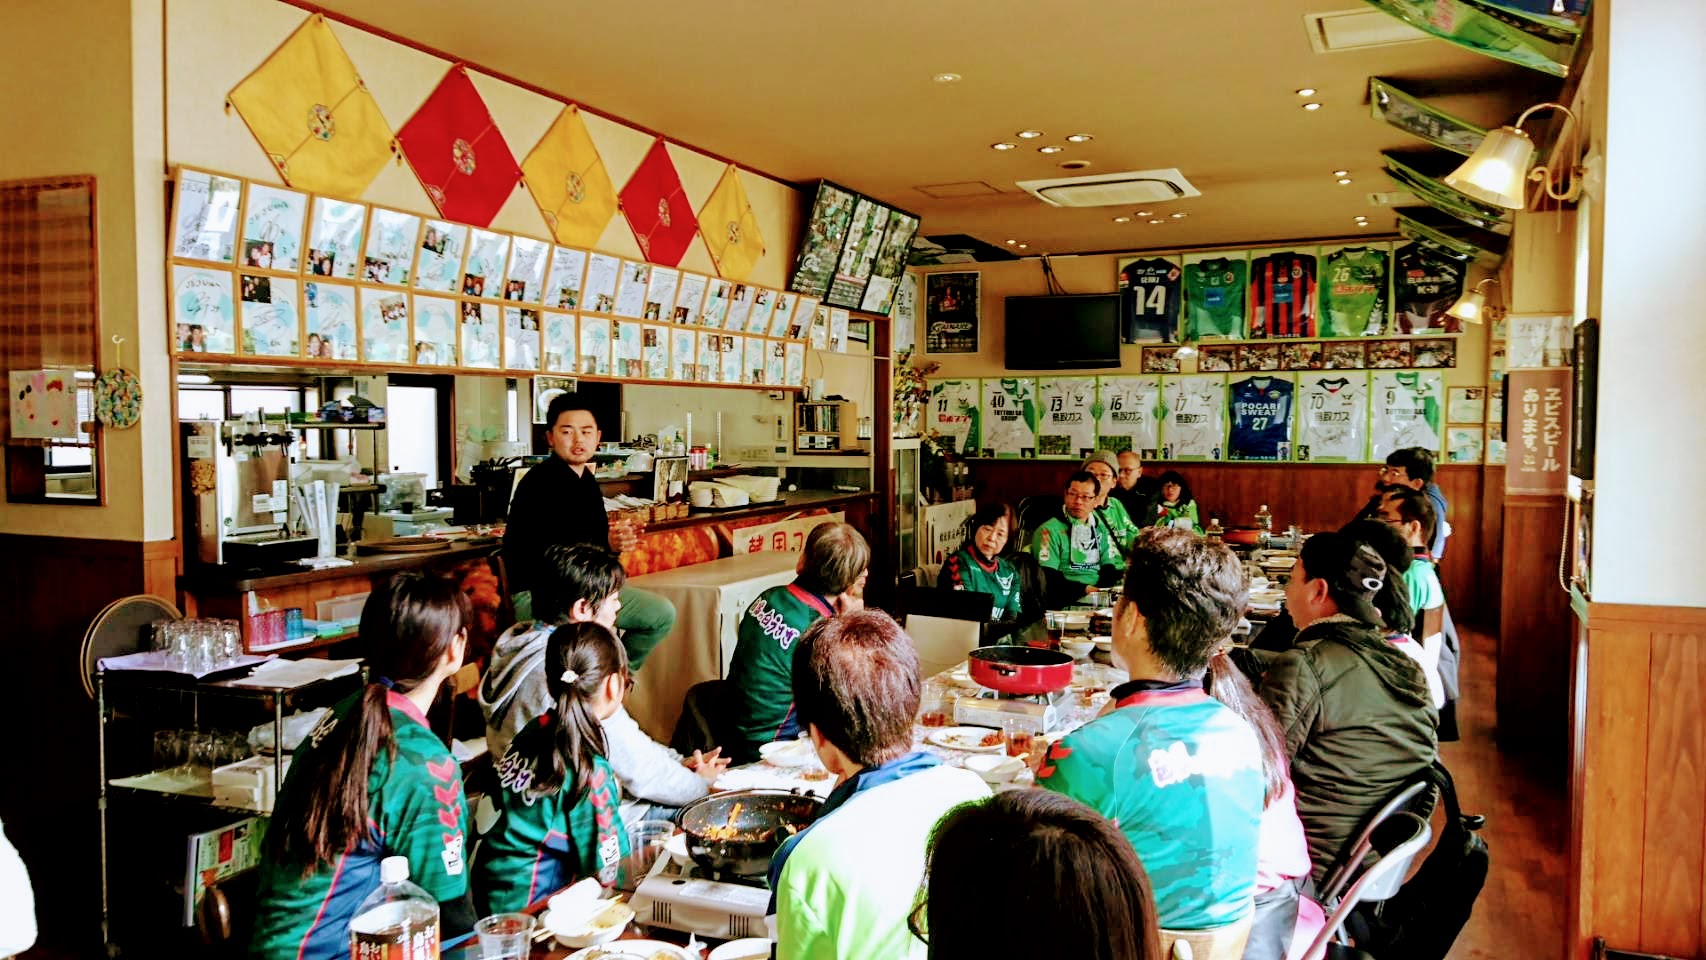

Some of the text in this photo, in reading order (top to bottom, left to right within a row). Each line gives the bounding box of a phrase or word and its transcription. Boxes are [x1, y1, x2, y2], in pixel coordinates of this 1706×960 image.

[1133, 285, 1166, 315] 14
[990, 395, 1005, 408] 40
[1310, 396, 1324, 409] 10
[1386, 390, 1395, 405] 9
[937, 399, 948, 412] 11
[1050, 399, 1063, 412] 13
[1110, 398, 1122, 411] 16
[1175, 398, 1187, 411] 17
[1052, 412, 1082, 423] 鳥取ガス
[1111, 411, 1143, 422] 鳥取ガス
[1176, 413, 1208, 424] 鳥取ガス
[1315, 411, 1350, 422] 鳥取ガス
[1252, 418, 1268, 431] 27
